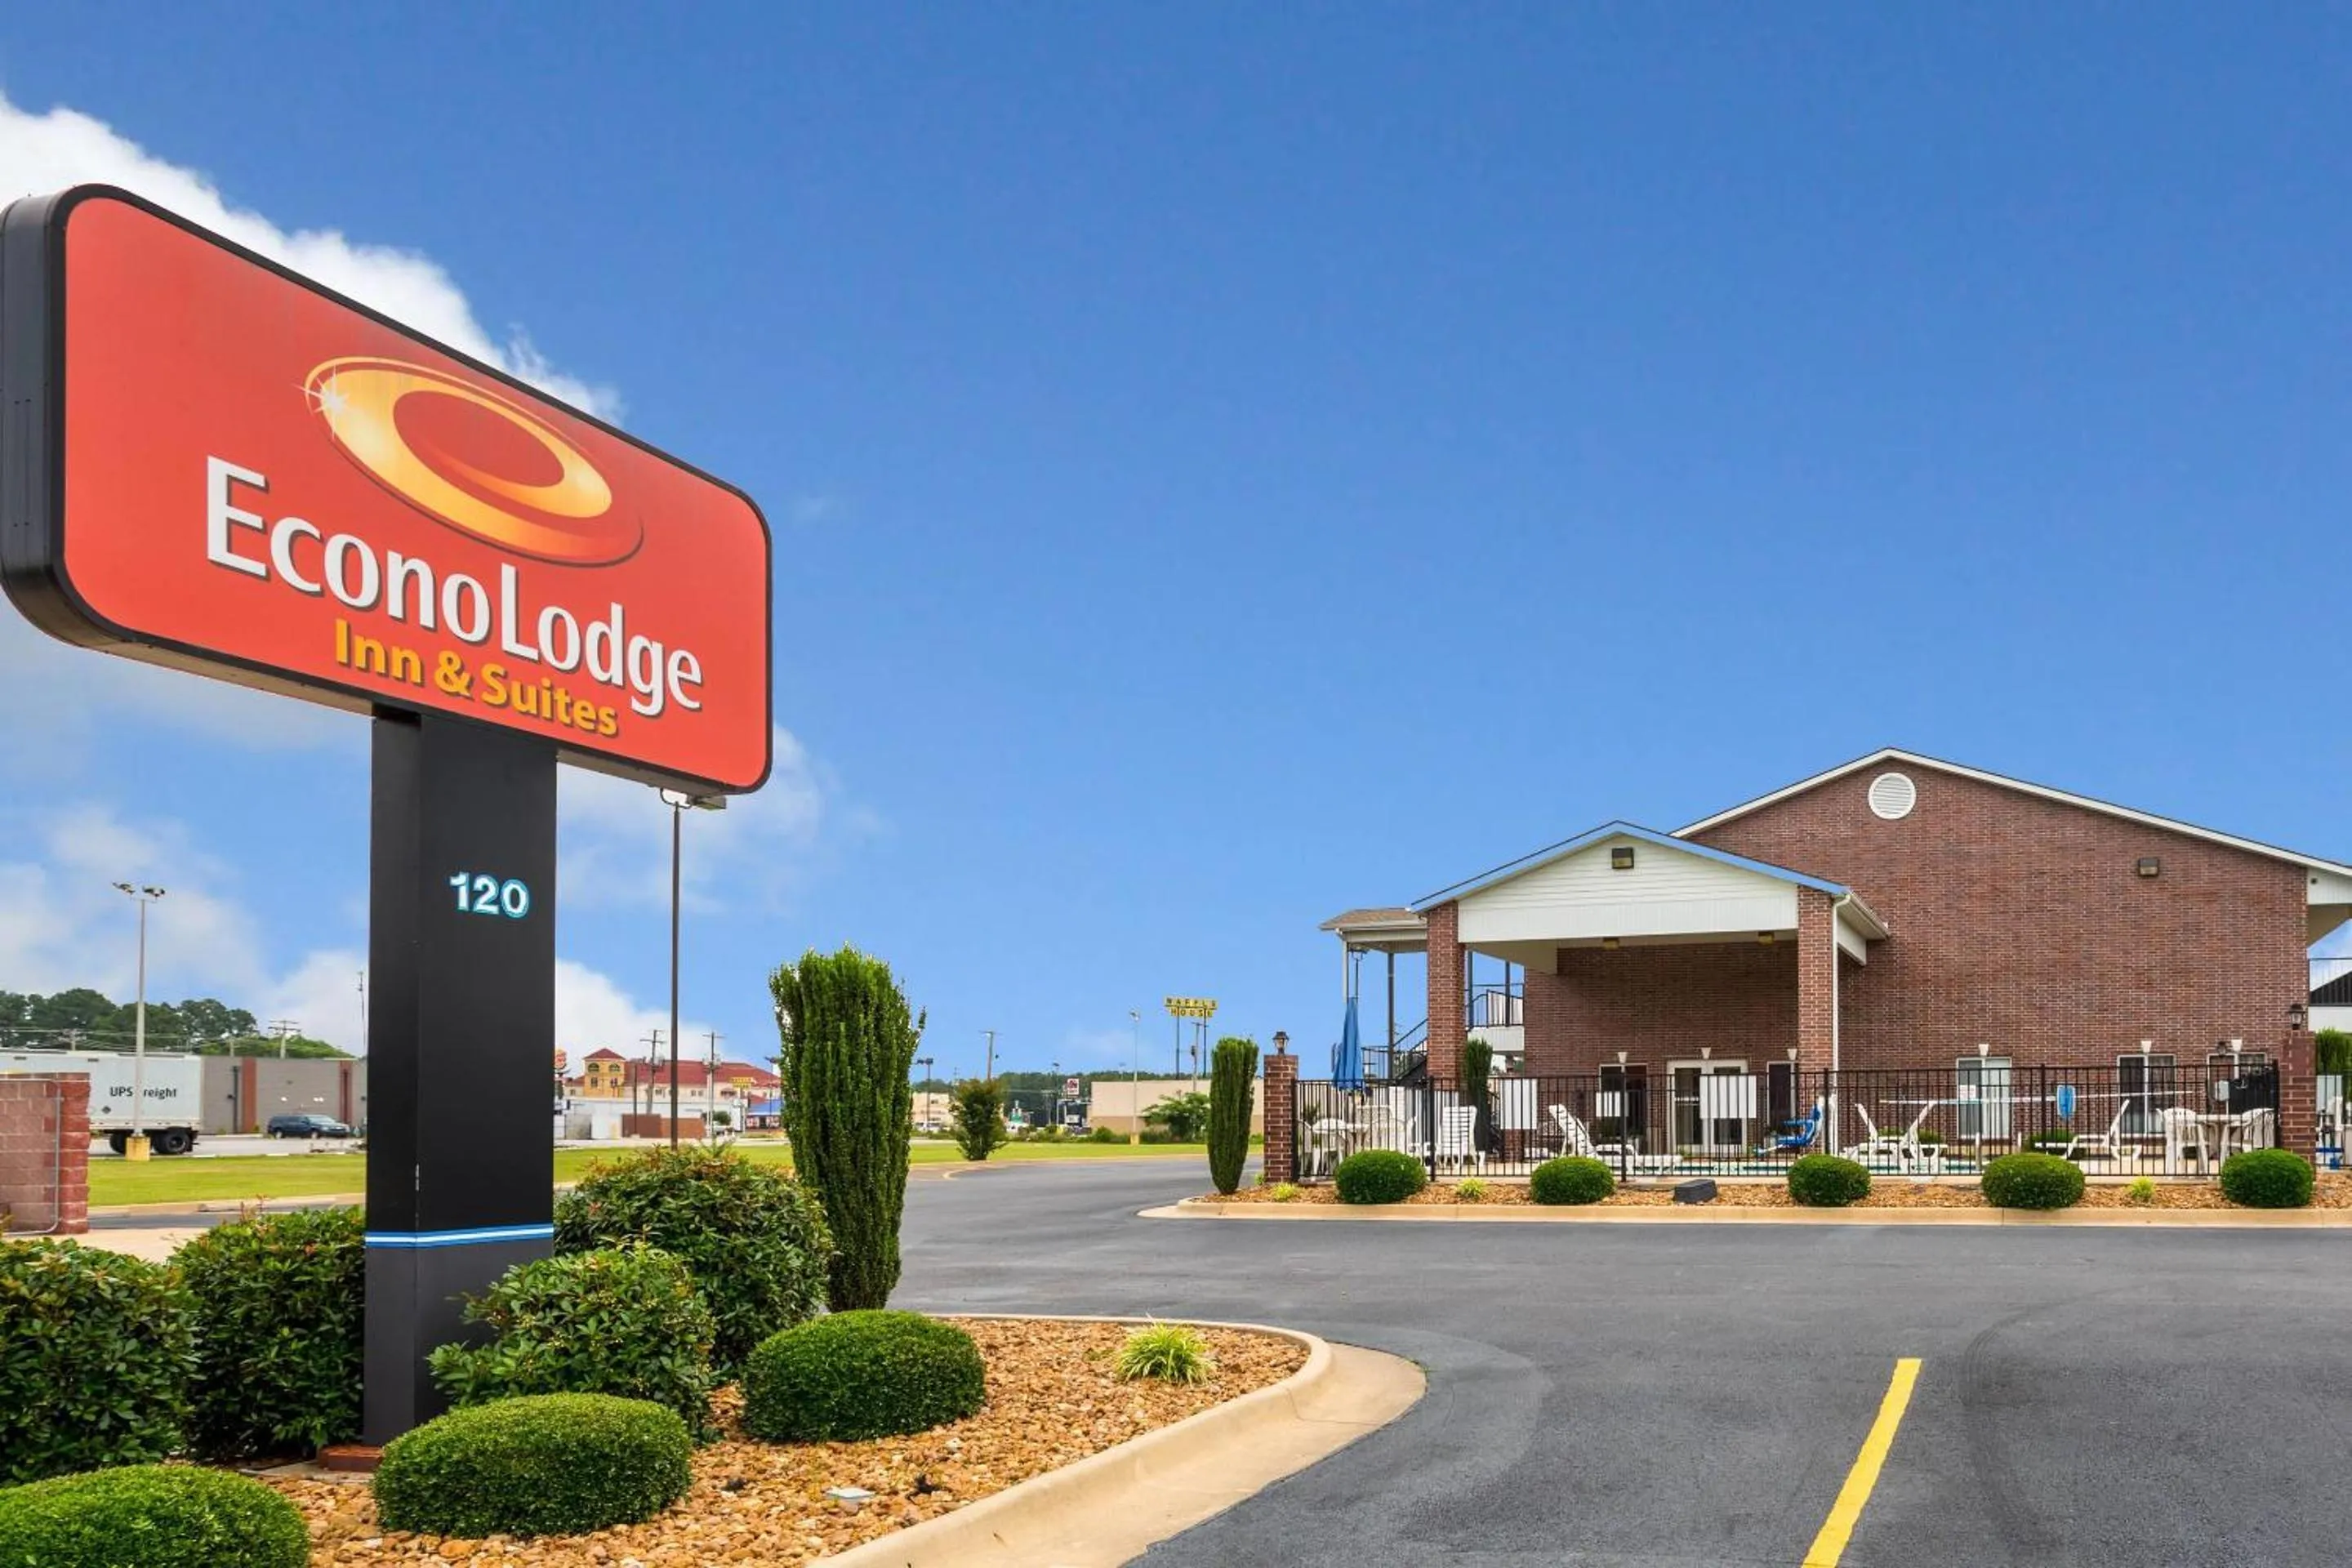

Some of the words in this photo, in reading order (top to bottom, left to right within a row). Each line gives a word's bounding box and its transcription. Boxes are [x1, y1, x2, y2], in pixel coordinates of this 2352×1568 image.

[206, 454, 703, 716] EconoLodge
[335, 618, 423, 685] Inn
[434, 651, 474, 698] &
[480, 663, 618, 736] Suites
[449, 871, 530, 919] 120
[109, 1086, 133, 1097] UPS
[139, 1087, 176, 1099] reight
